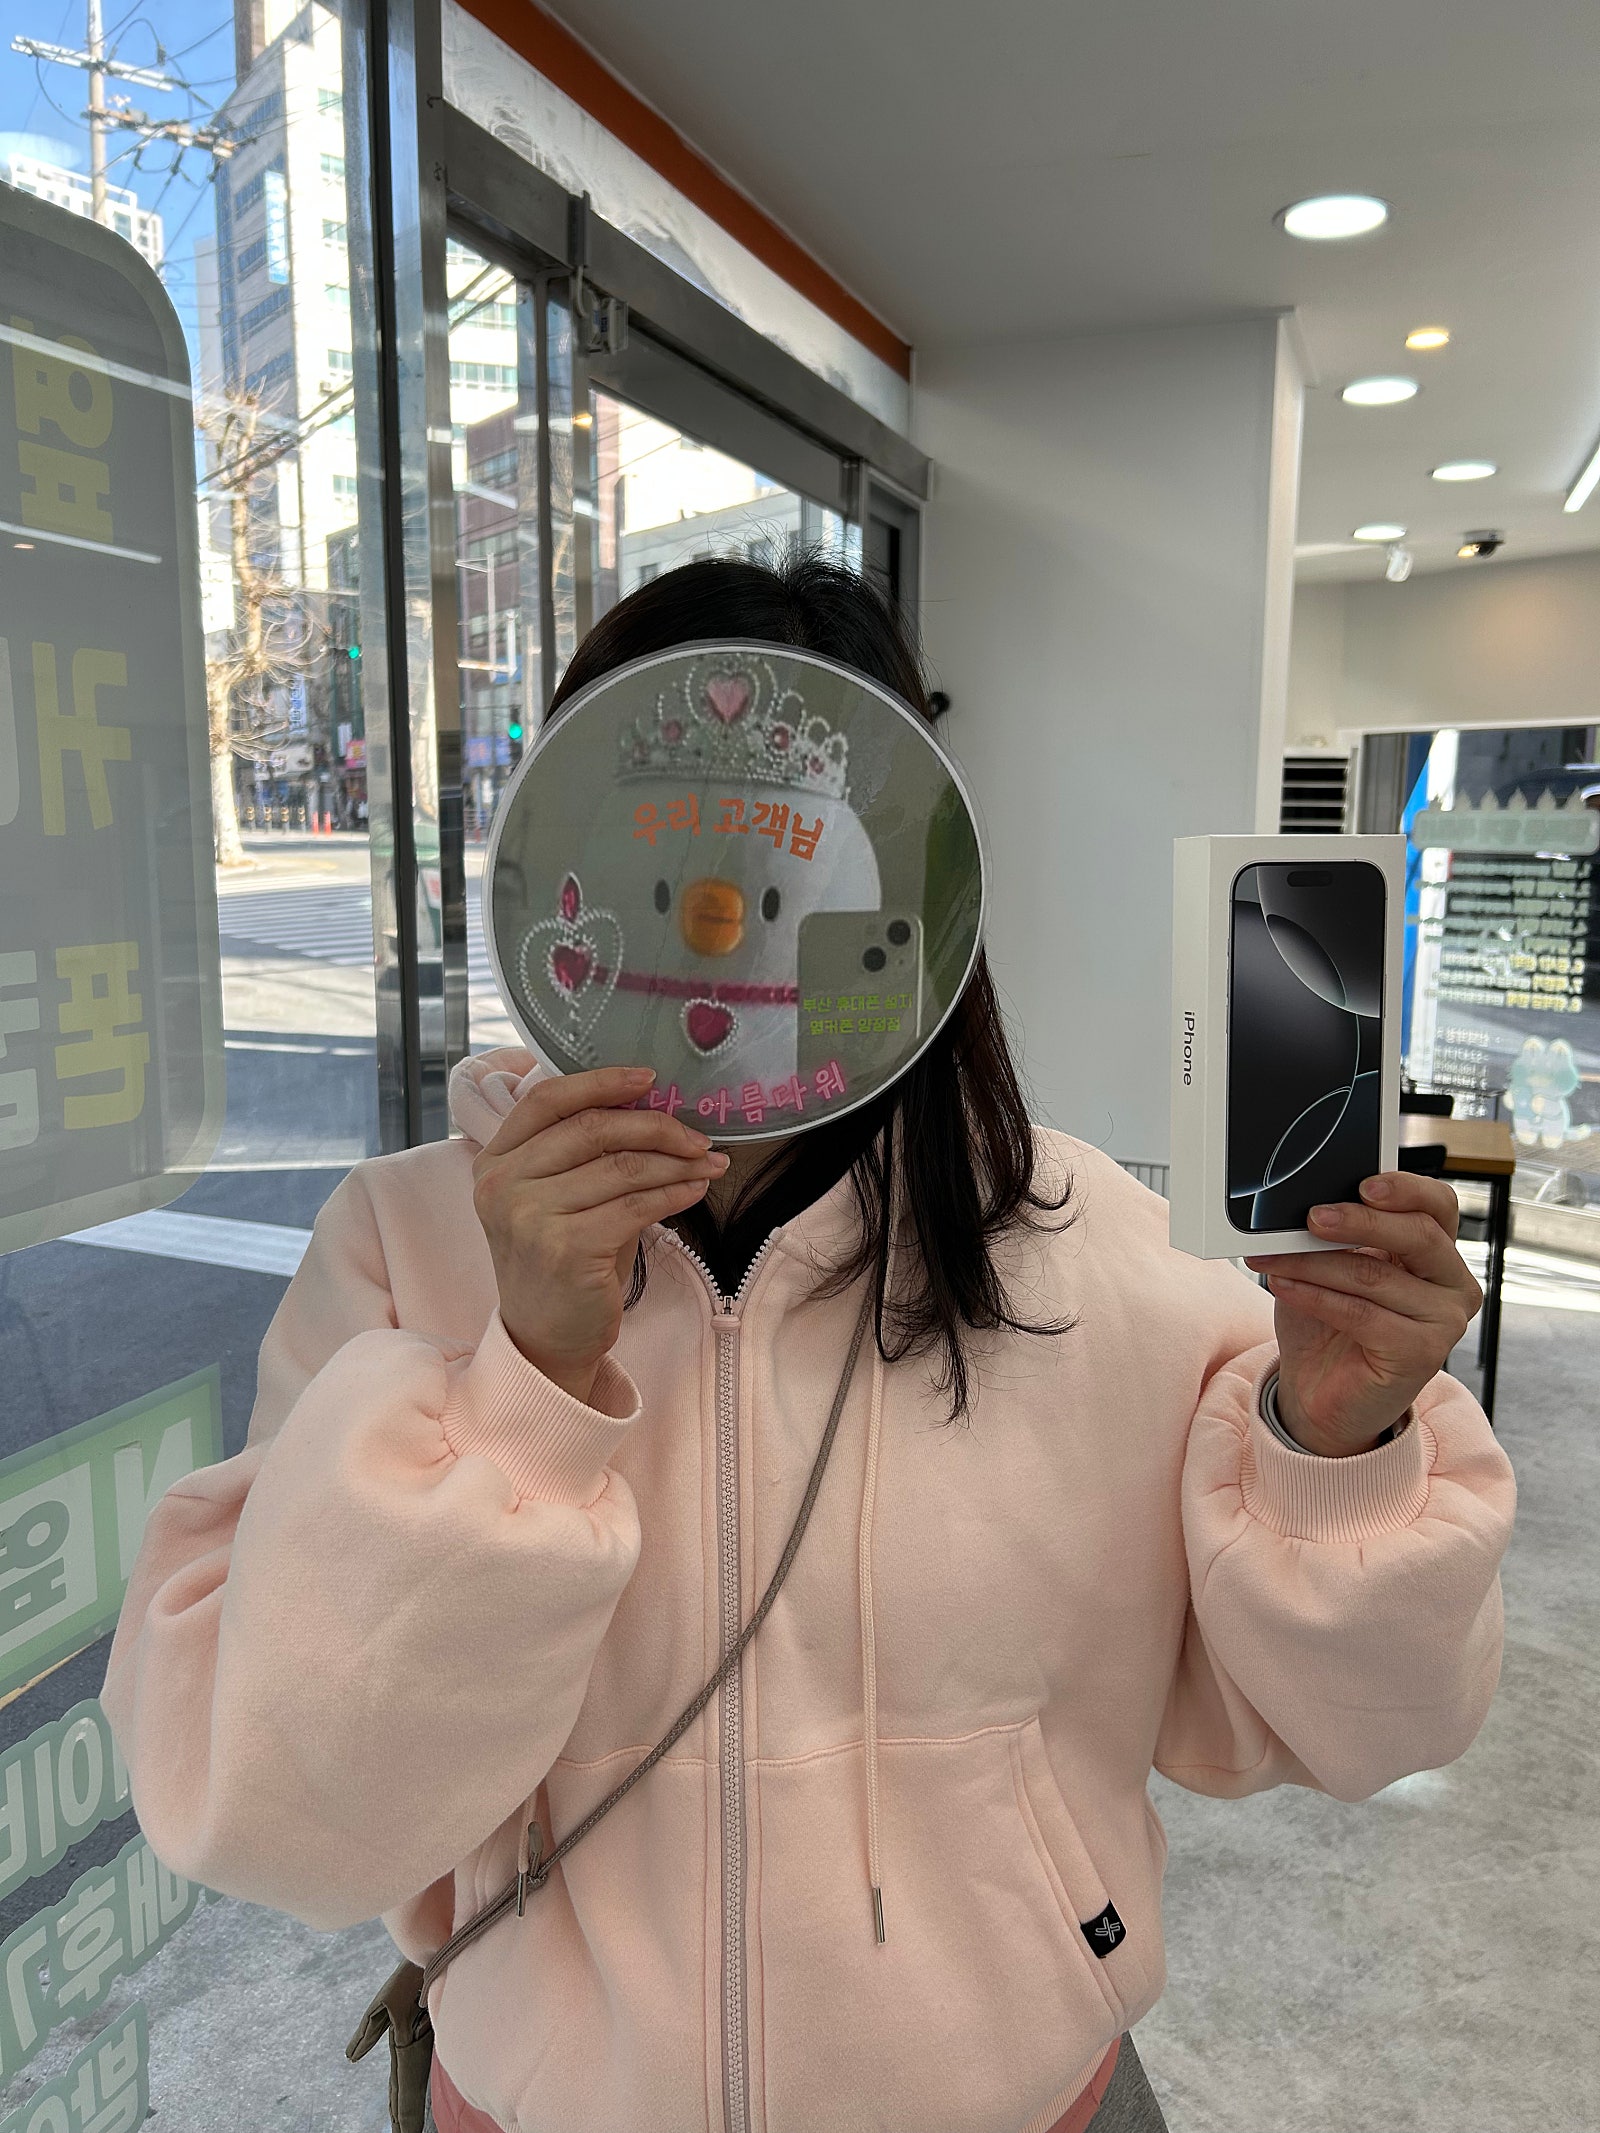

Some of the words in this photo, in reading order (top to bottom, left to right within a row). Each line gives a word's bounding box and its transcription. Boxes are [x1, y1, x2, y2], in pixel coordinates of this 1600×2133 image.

[633, 792, 701, 847] 우리
[713, 797, 825, 862] 고객님
[803, 996, 832, 1013] 부산
[836, 994, 880, 1012] 휴대폰
[858, 1016, 901, 1033] 양정점
[1183, 1011, 1195, 1086] iPhone
[697, 1060, 846, 1124] 아름다워
